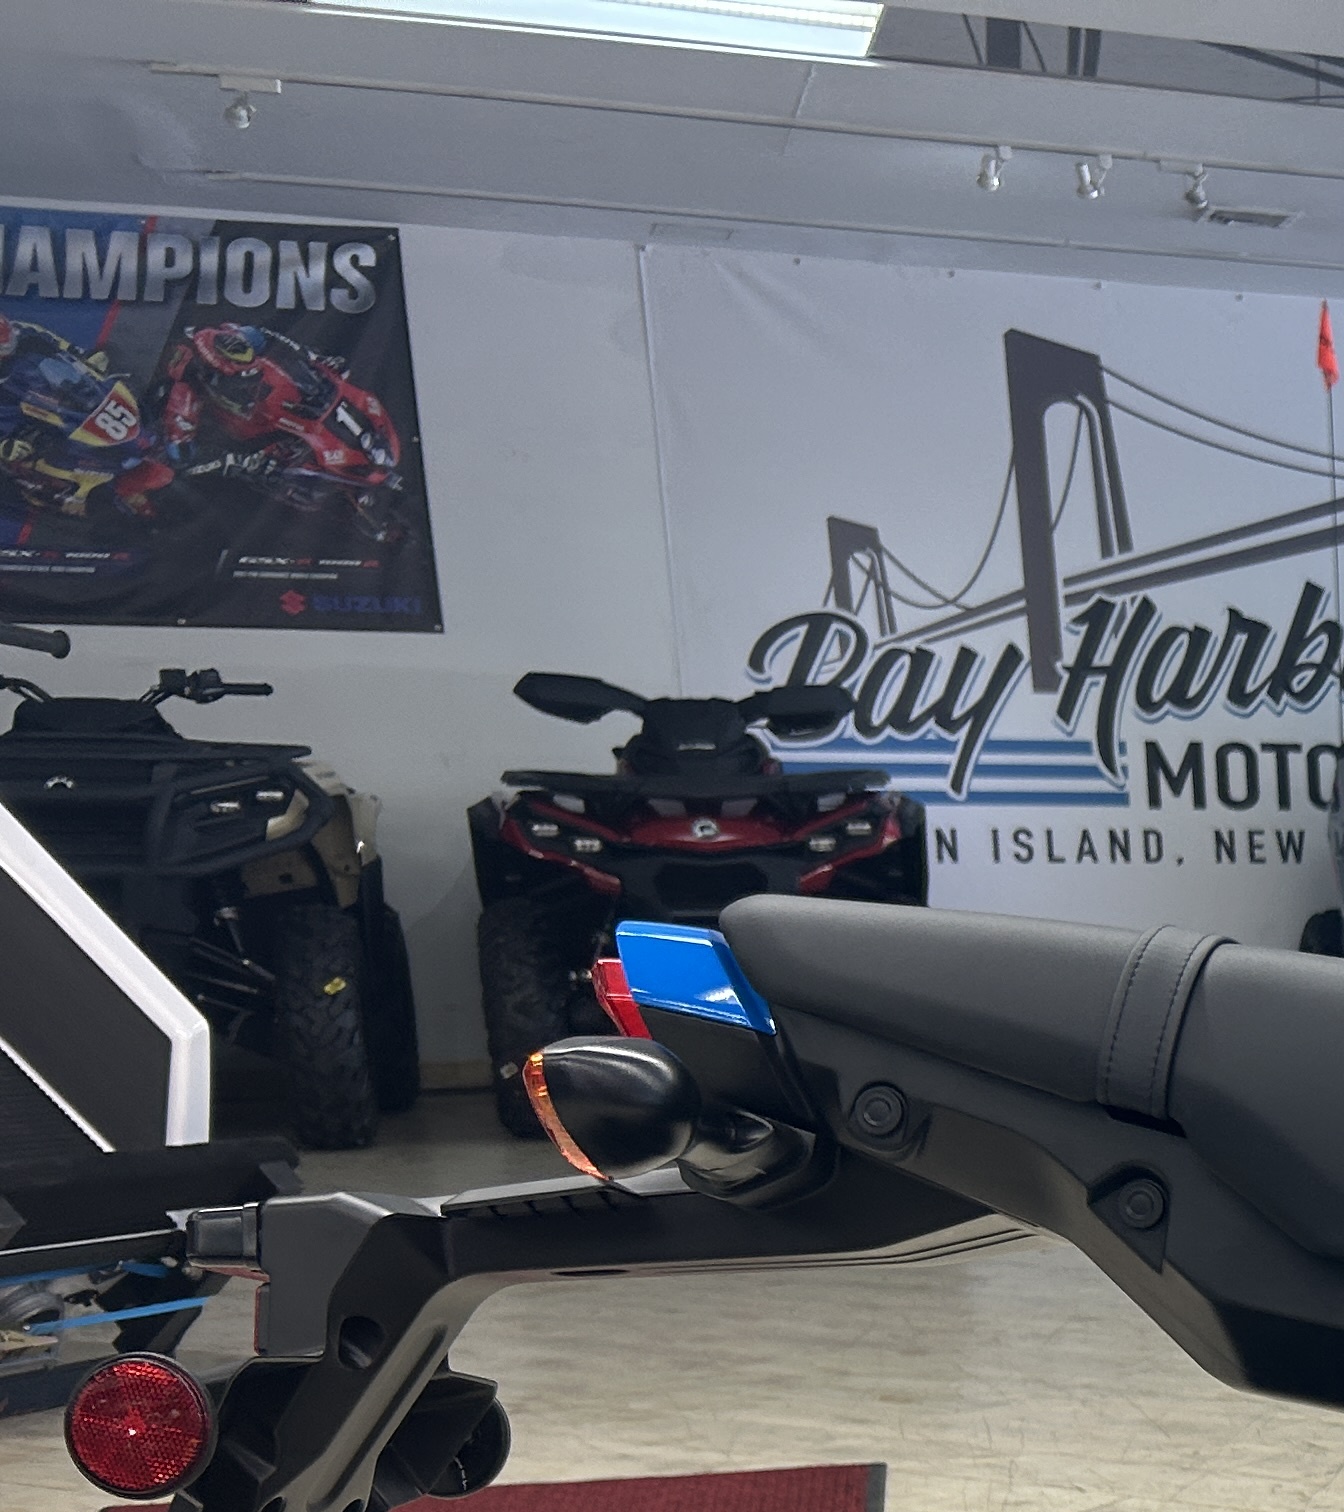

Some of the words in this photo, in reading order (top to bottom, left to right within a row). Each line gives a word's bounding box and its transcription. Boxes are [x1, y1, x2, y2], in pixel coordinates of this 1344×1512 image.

[0, 224, 376, 314] AMPIONS
[94, 399, 138, 440] 85
[312, 595, 421, 614] SUZUKI
[749, 612, 1027, 796] Bay
[992, 828, 1184, 867] ISLAND,
[1215, 829, 1306, 864] NEW
